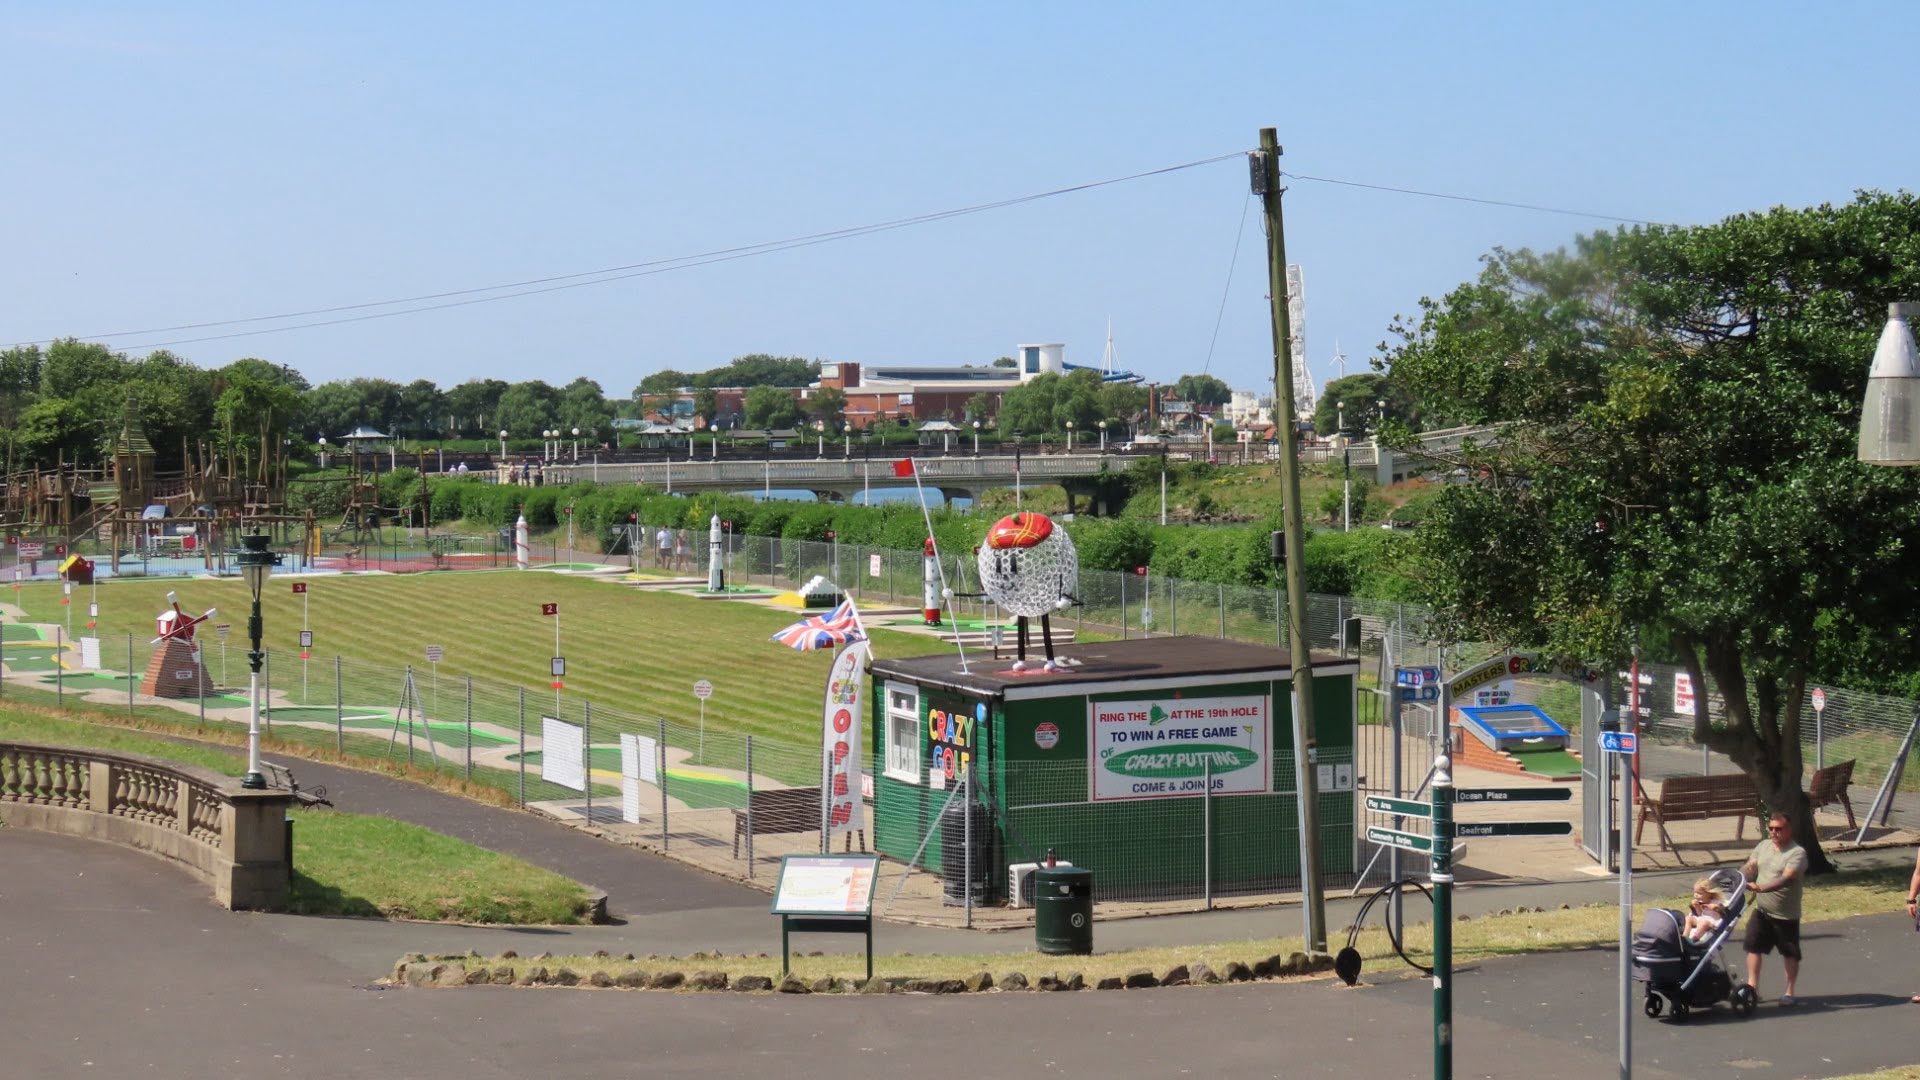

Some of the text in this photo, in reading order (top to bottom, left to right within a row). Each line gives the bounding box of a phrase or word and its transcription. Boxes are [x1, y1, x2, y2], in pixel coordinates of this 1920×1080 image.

[547, 605, 553, 613] 2
[1454, 665, 1504, 693] MASTERS
[1100, 706, 1258, 723] RING THE AT THE 19th HOLE
[928, 708, 974, 748] CRAZY
[1111, 726, 1237, 743] TO WIN A FREE GAME
[1100, 748, 1114, 759] OF
[933, 745, 970, 781] GOLF
[1125, 753, 1174, 770] CRAZY
[1132, 779, 1224, 793] COME & JOIN US
[1460, 791, 1508, 800] Ocean Plaza
[1368, 799, 1392, 810] Play Area
[1370, 831, 1394, 843] Community
[1461, 826, 1492, 835] Seafront
